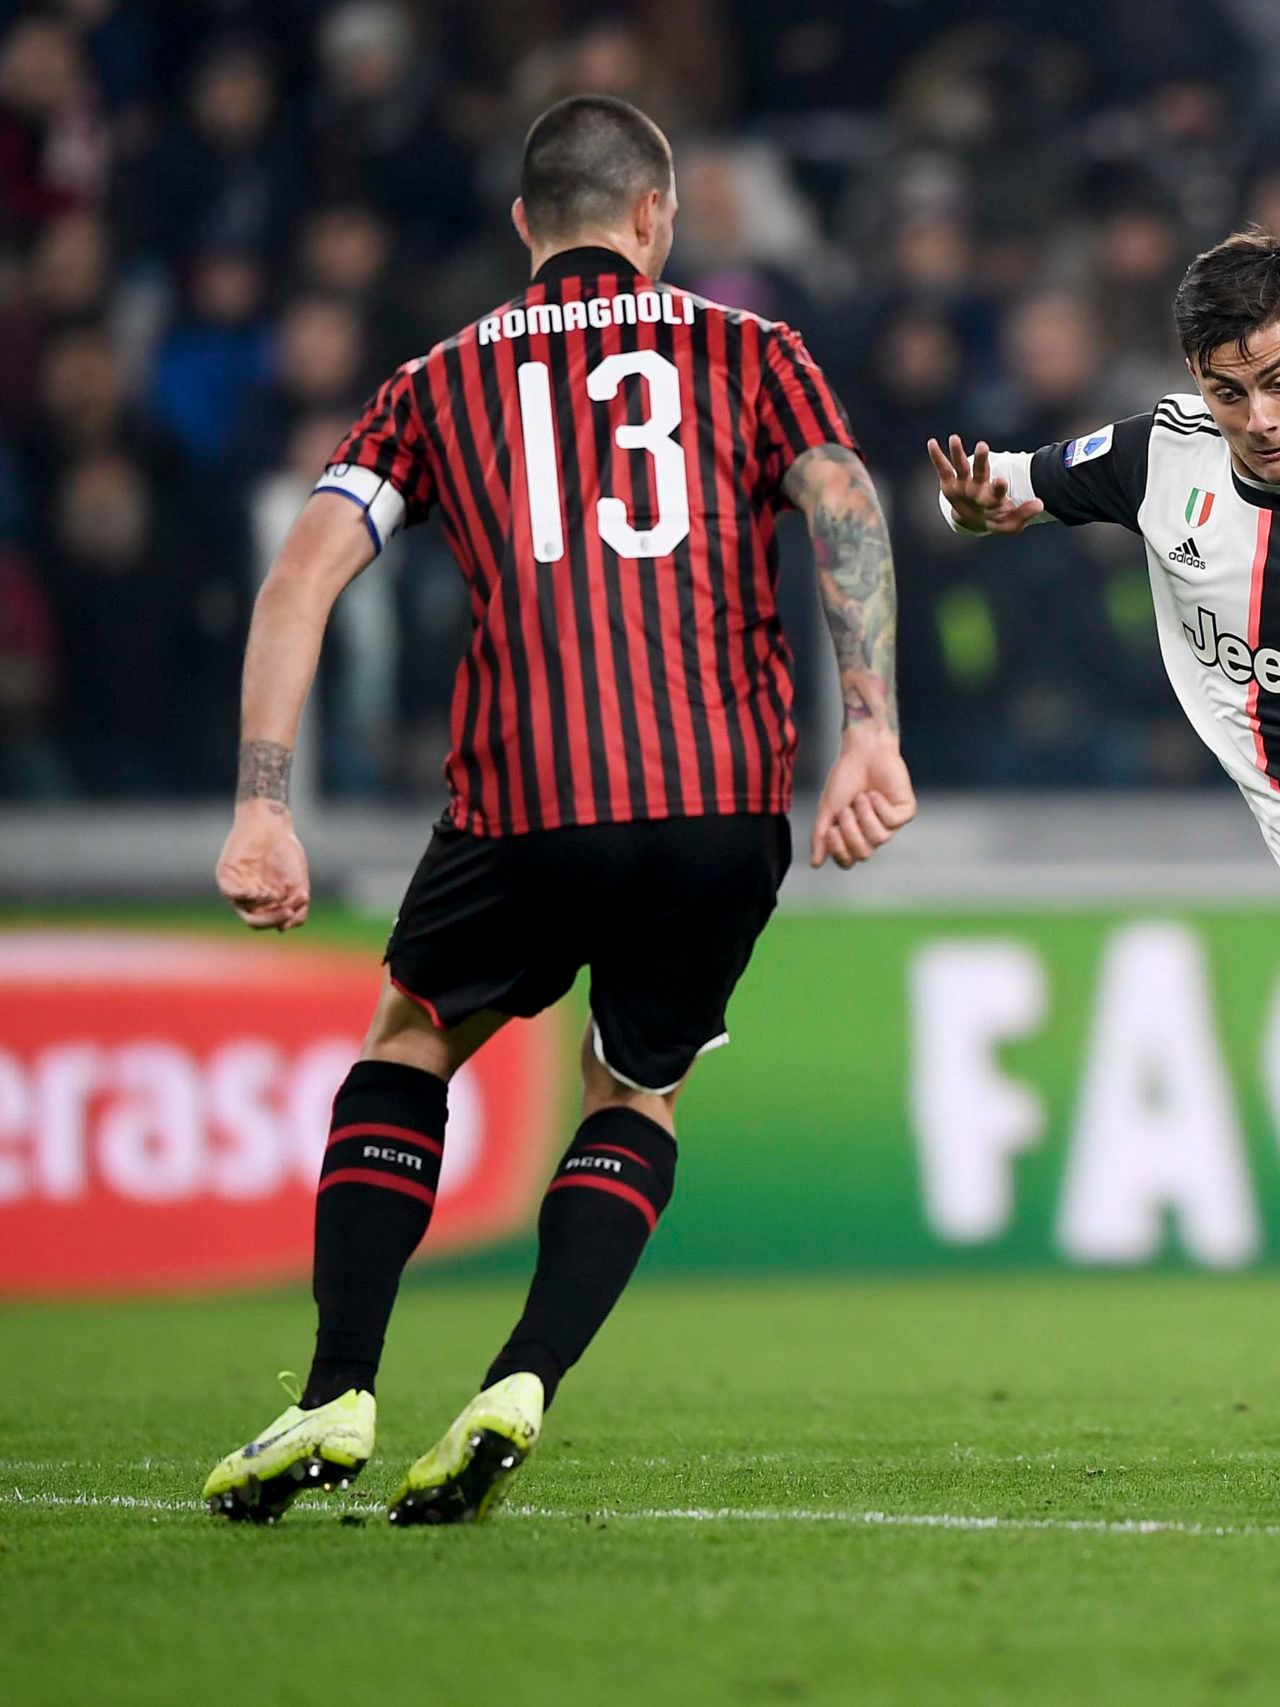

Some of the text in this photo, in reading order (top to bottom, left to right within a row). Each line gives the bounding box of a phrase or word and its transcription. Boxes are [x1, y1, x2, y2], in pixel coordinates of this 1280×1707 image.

[479, 292, 695, 346] ROMAGNOLI
[517, 349, 690, 563] 13
[1168, 550, 1206, 570] adidas
[363, 1145, 422, 1170] ACM
[565, 1156, 622, 1173] ACM
